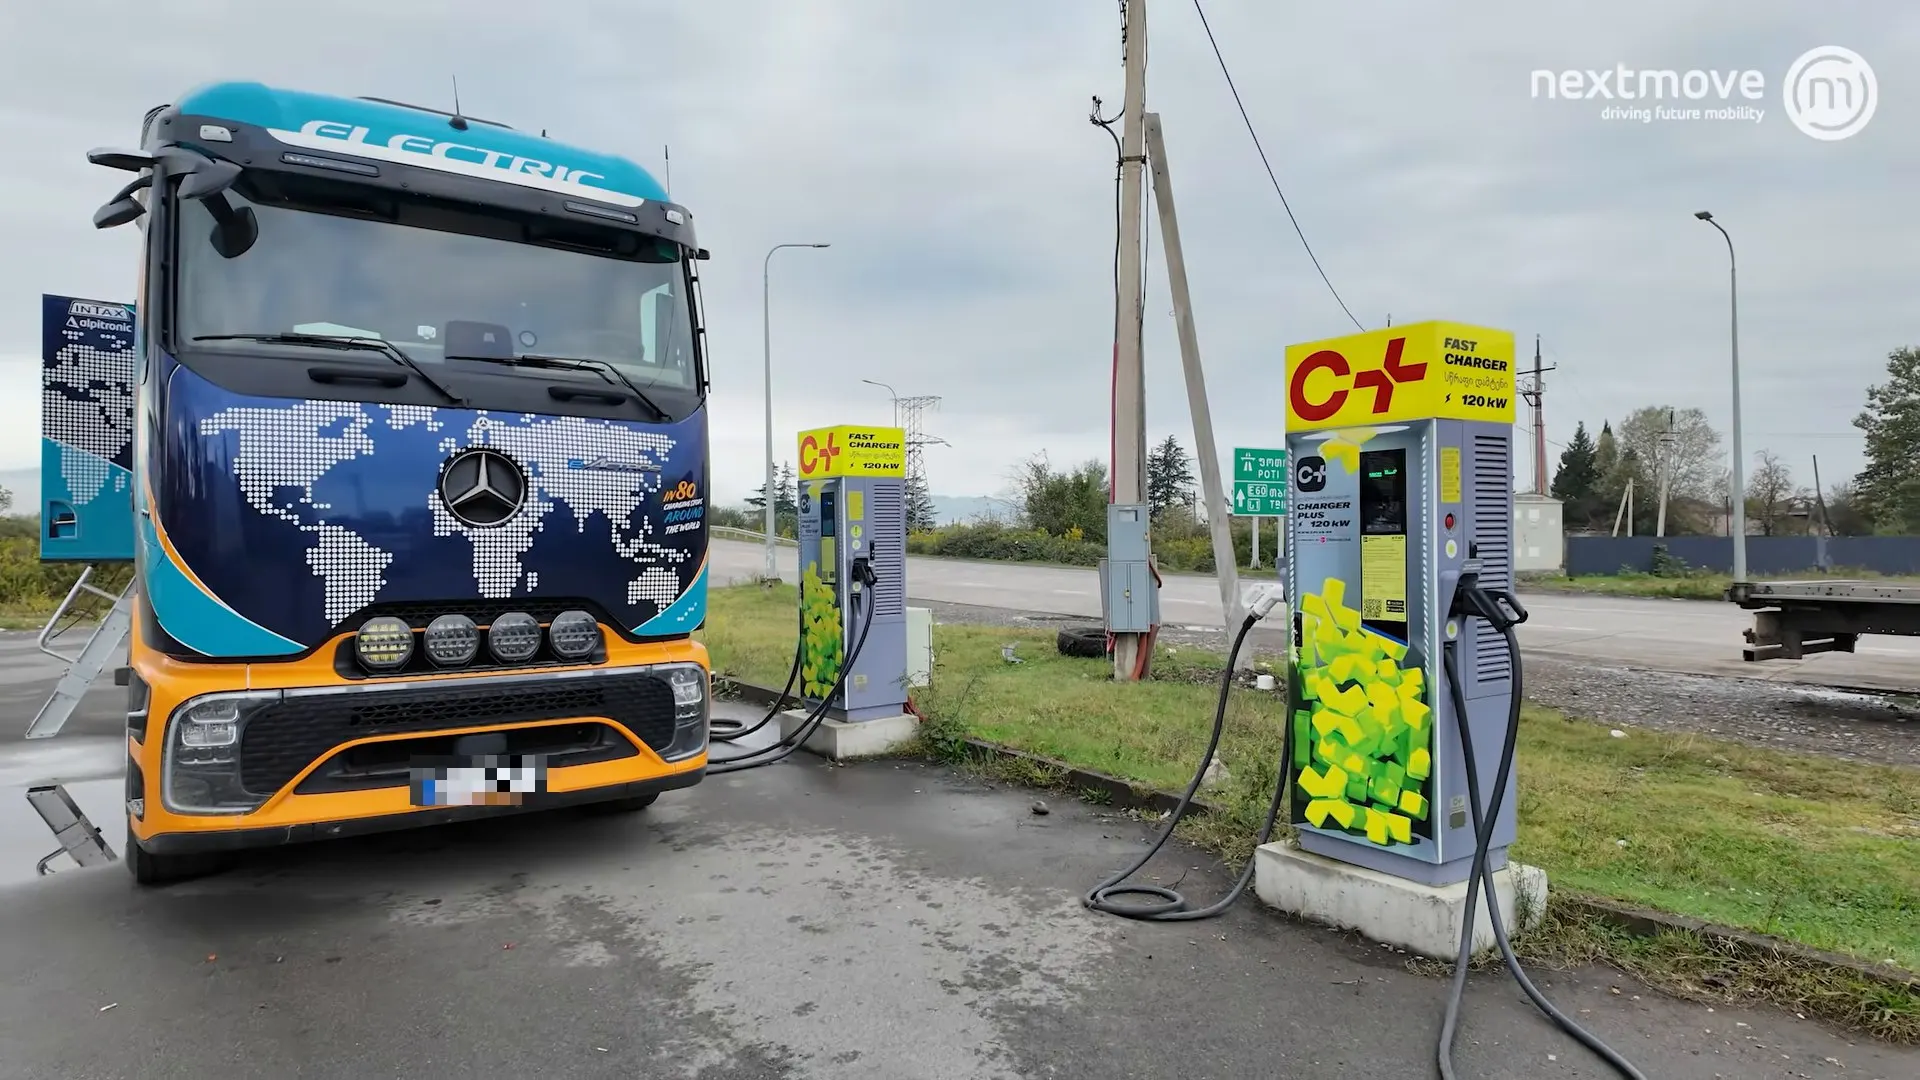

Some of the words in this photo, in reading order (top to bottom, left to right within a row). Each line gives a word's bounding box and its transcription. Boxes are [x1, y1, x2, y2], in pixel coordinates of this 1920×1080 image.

[301, 120, 605, 186] ELECTRIC
[75, 304, 124, 317] INTAX
[79, 319, 132, 332] alpitronic
[1444, 337, 1478, 352] FAST
[1444, 353, 1508, 372] CHARGER
[1462, 394, 1486, 407] 120
[1486, 397, 1508, 409] kW
[849, 441, 900, 450] CHARGER
[1258, 469, 1280, 479] POTI
[663, 490, 676, 502] IN
[676, 480, 696, 500] 80
[1248, 485, 1267, 496] E60
[1297, 502, 1351, 510] CHARGER
[664, 506, 704, 523] AROUND
[1297, 511, 1325, 519] PLUS
[665, 524, 680, 535] THE
[679, 521, 701, 532] WORLD
[1310, 520, 1331, 528] 120
